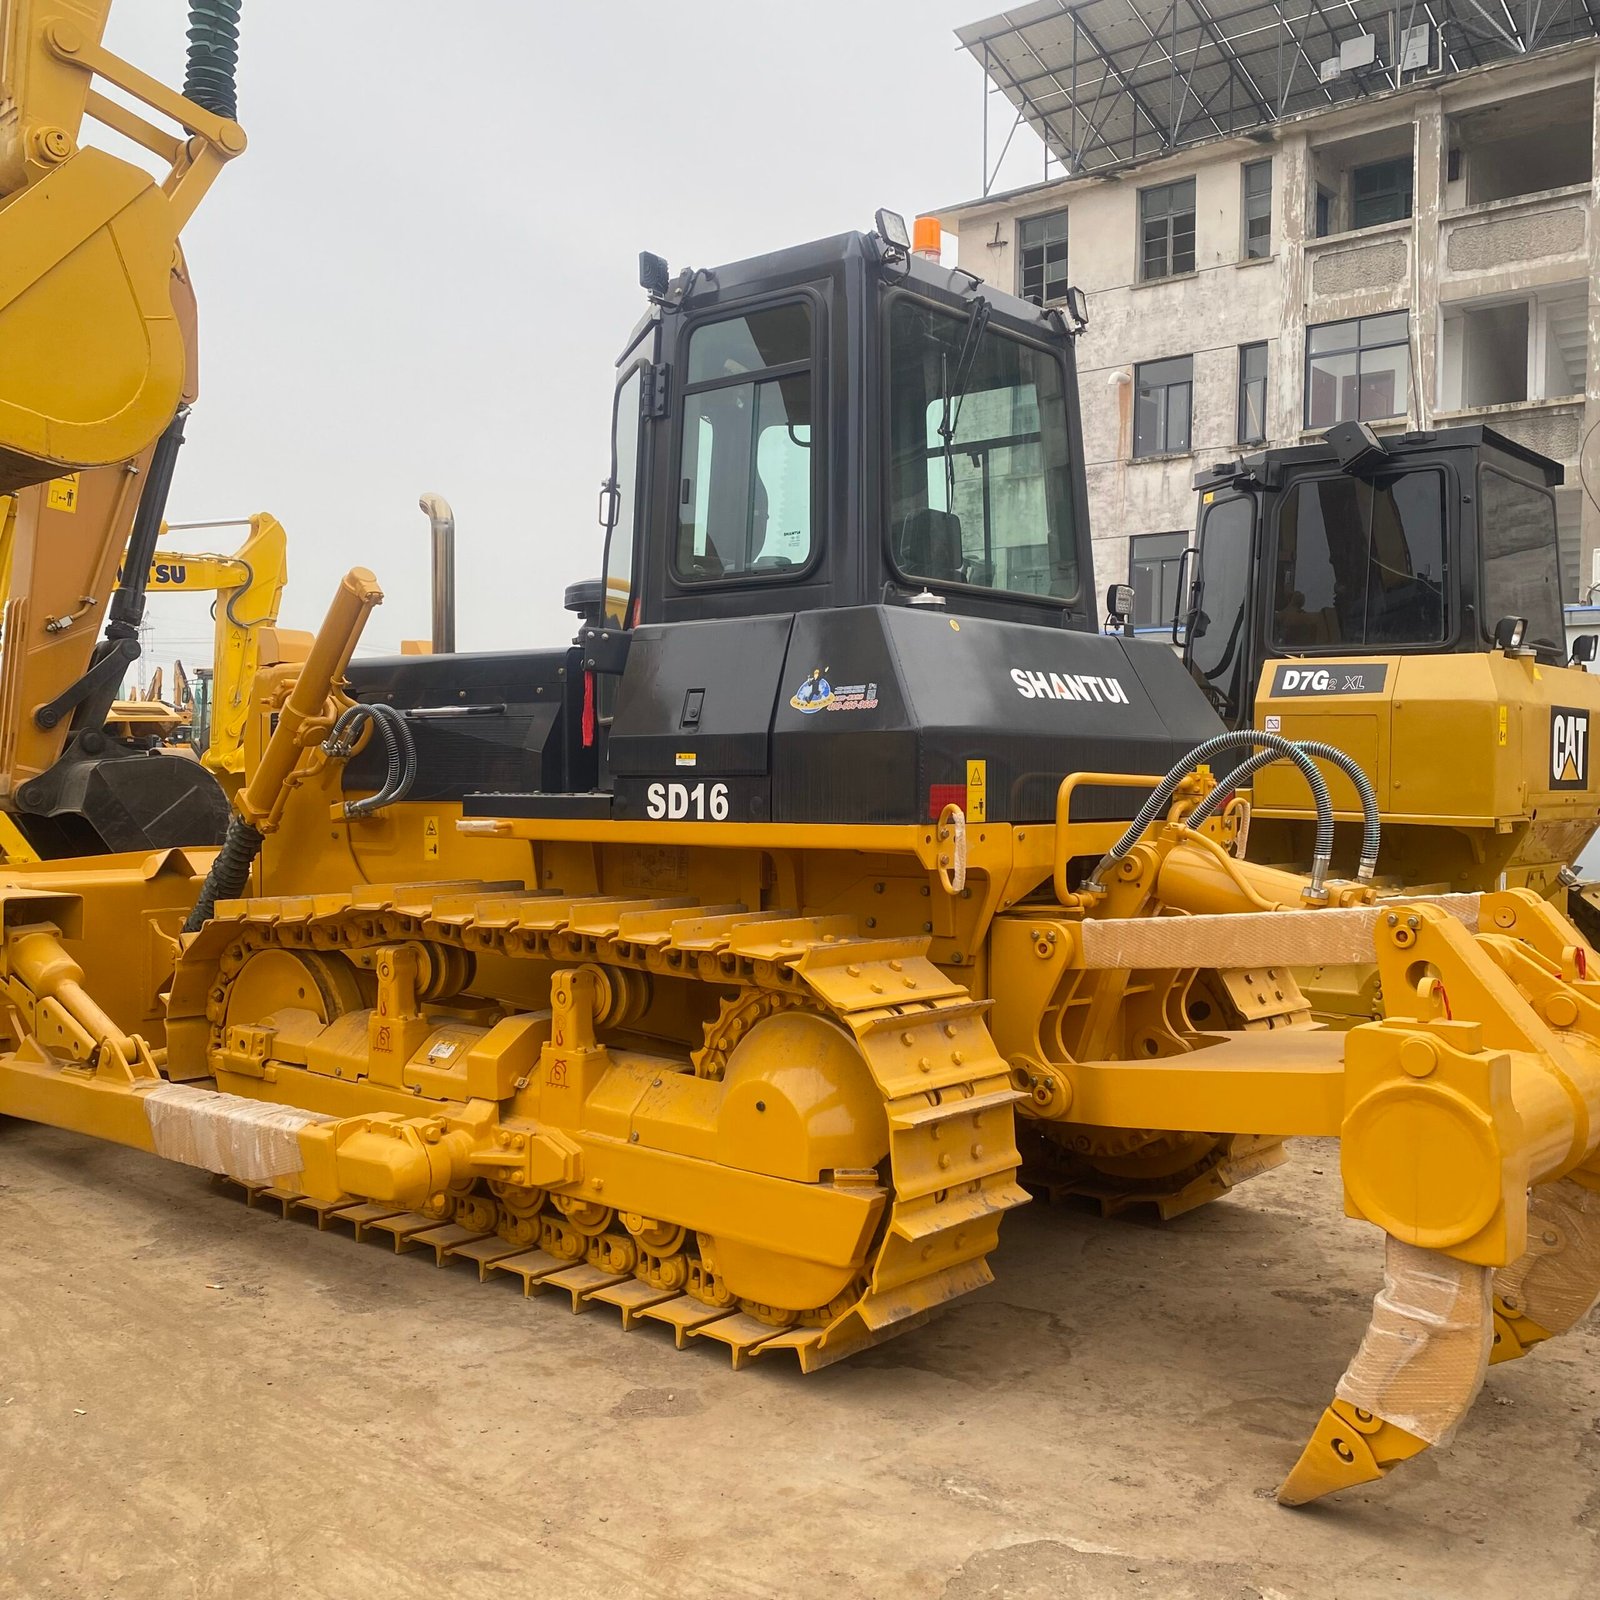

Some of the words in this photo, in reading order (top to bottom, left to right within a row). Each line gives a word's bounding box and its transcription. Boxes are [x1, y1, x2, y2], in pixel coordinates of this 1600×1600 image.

[1010, 668, 1130, 705] SHANTUI
[1341, 675, 1365, 690] XL
[1553, 714, 1587, 780] CAT
[646, 782, 729, 821] SD16
